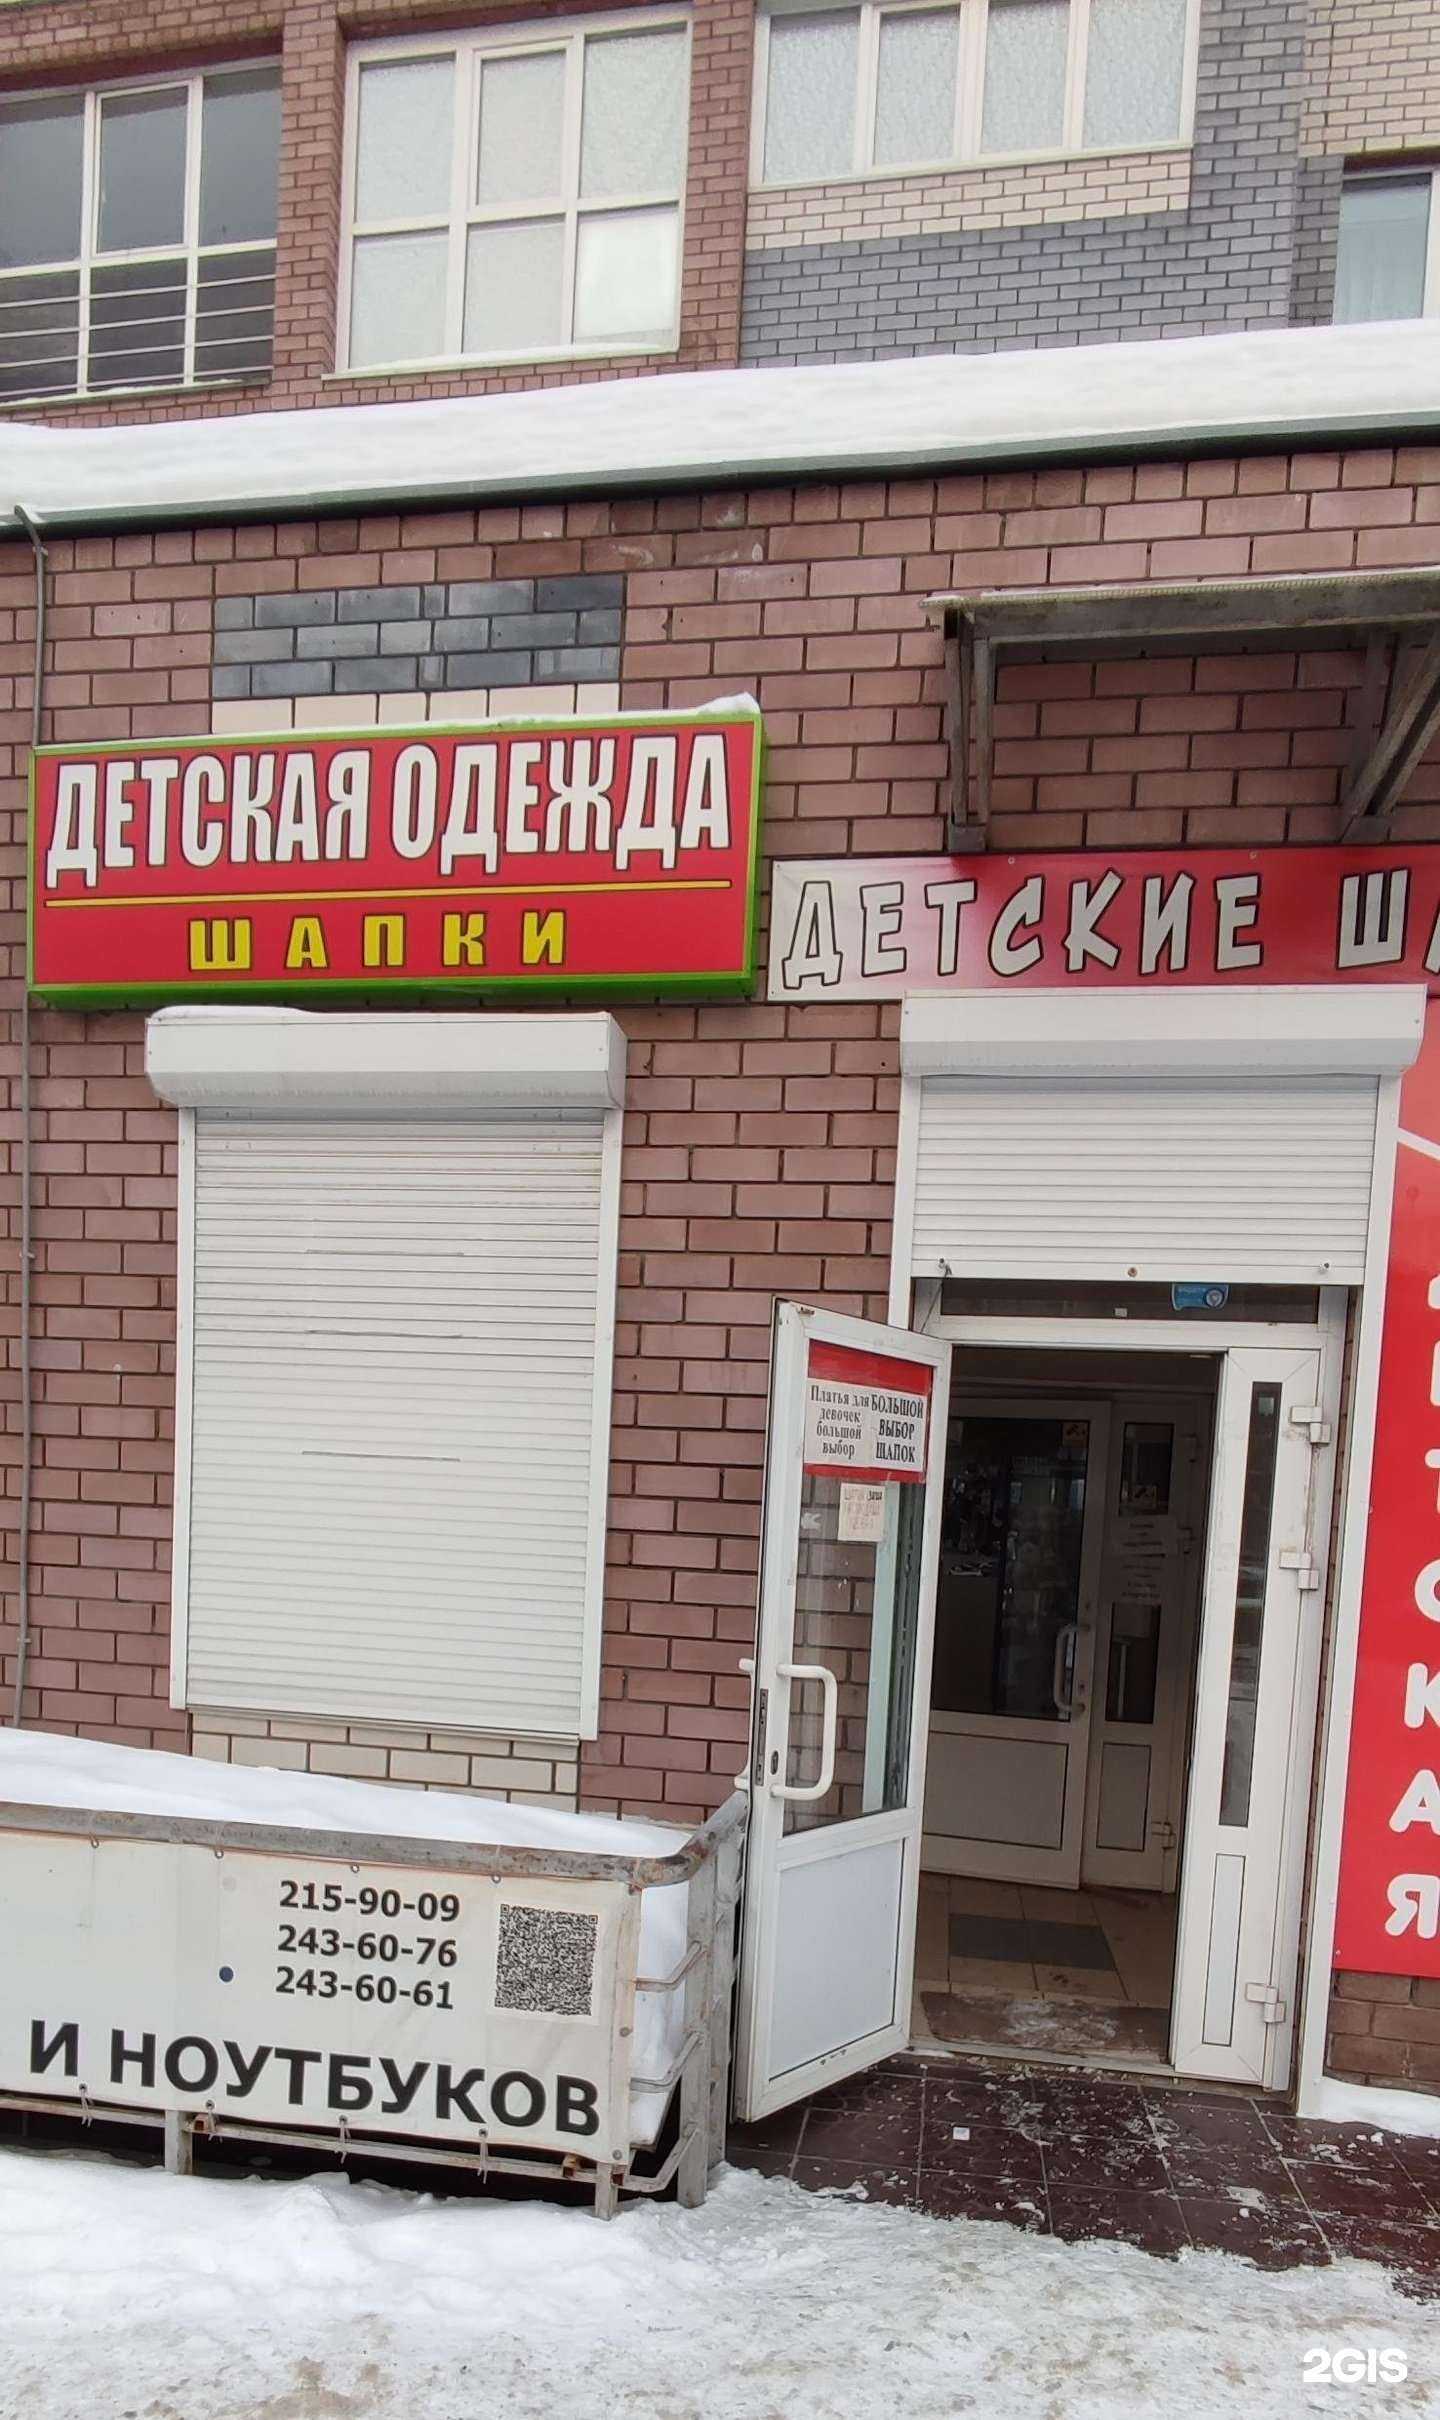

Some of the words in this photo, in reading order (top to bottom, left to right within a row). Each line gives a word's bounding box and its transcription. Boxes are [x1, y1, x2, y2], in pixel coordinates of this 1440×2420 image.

[45, 749, 373, 889] ДЕТСКАЯ
[390, 733, 731, 876] ОДЕЖДА
[188, 910, 567, 971] ШАПКИ
[781, 868, 1264, 989] ДЕТСКИЕ
[810, 1384, 849, 1405] Платья
[852, 1394, 870, 1407] для
[871, 1394, 924, 1419] БОЛЬШОЙ
[816, 1421, 862, 1440] большой
[820, 1408, 861, 1423] девочек
[879, 1419, 915, 1440] ВЫБОР
[822, 1439, 855, 1460] выбор
[876, 1442, 915, 1462] ШАПОК
[279, 1880, 461, 1922] 215-90-09
[277, 1924, 457, 1967] 243-60-76
[275, 1966, 454, 2009] 243-60-61
[30, 2019, 79, 2077] И
[110, 2029, 600, 2136] НОУТБУКОВ
